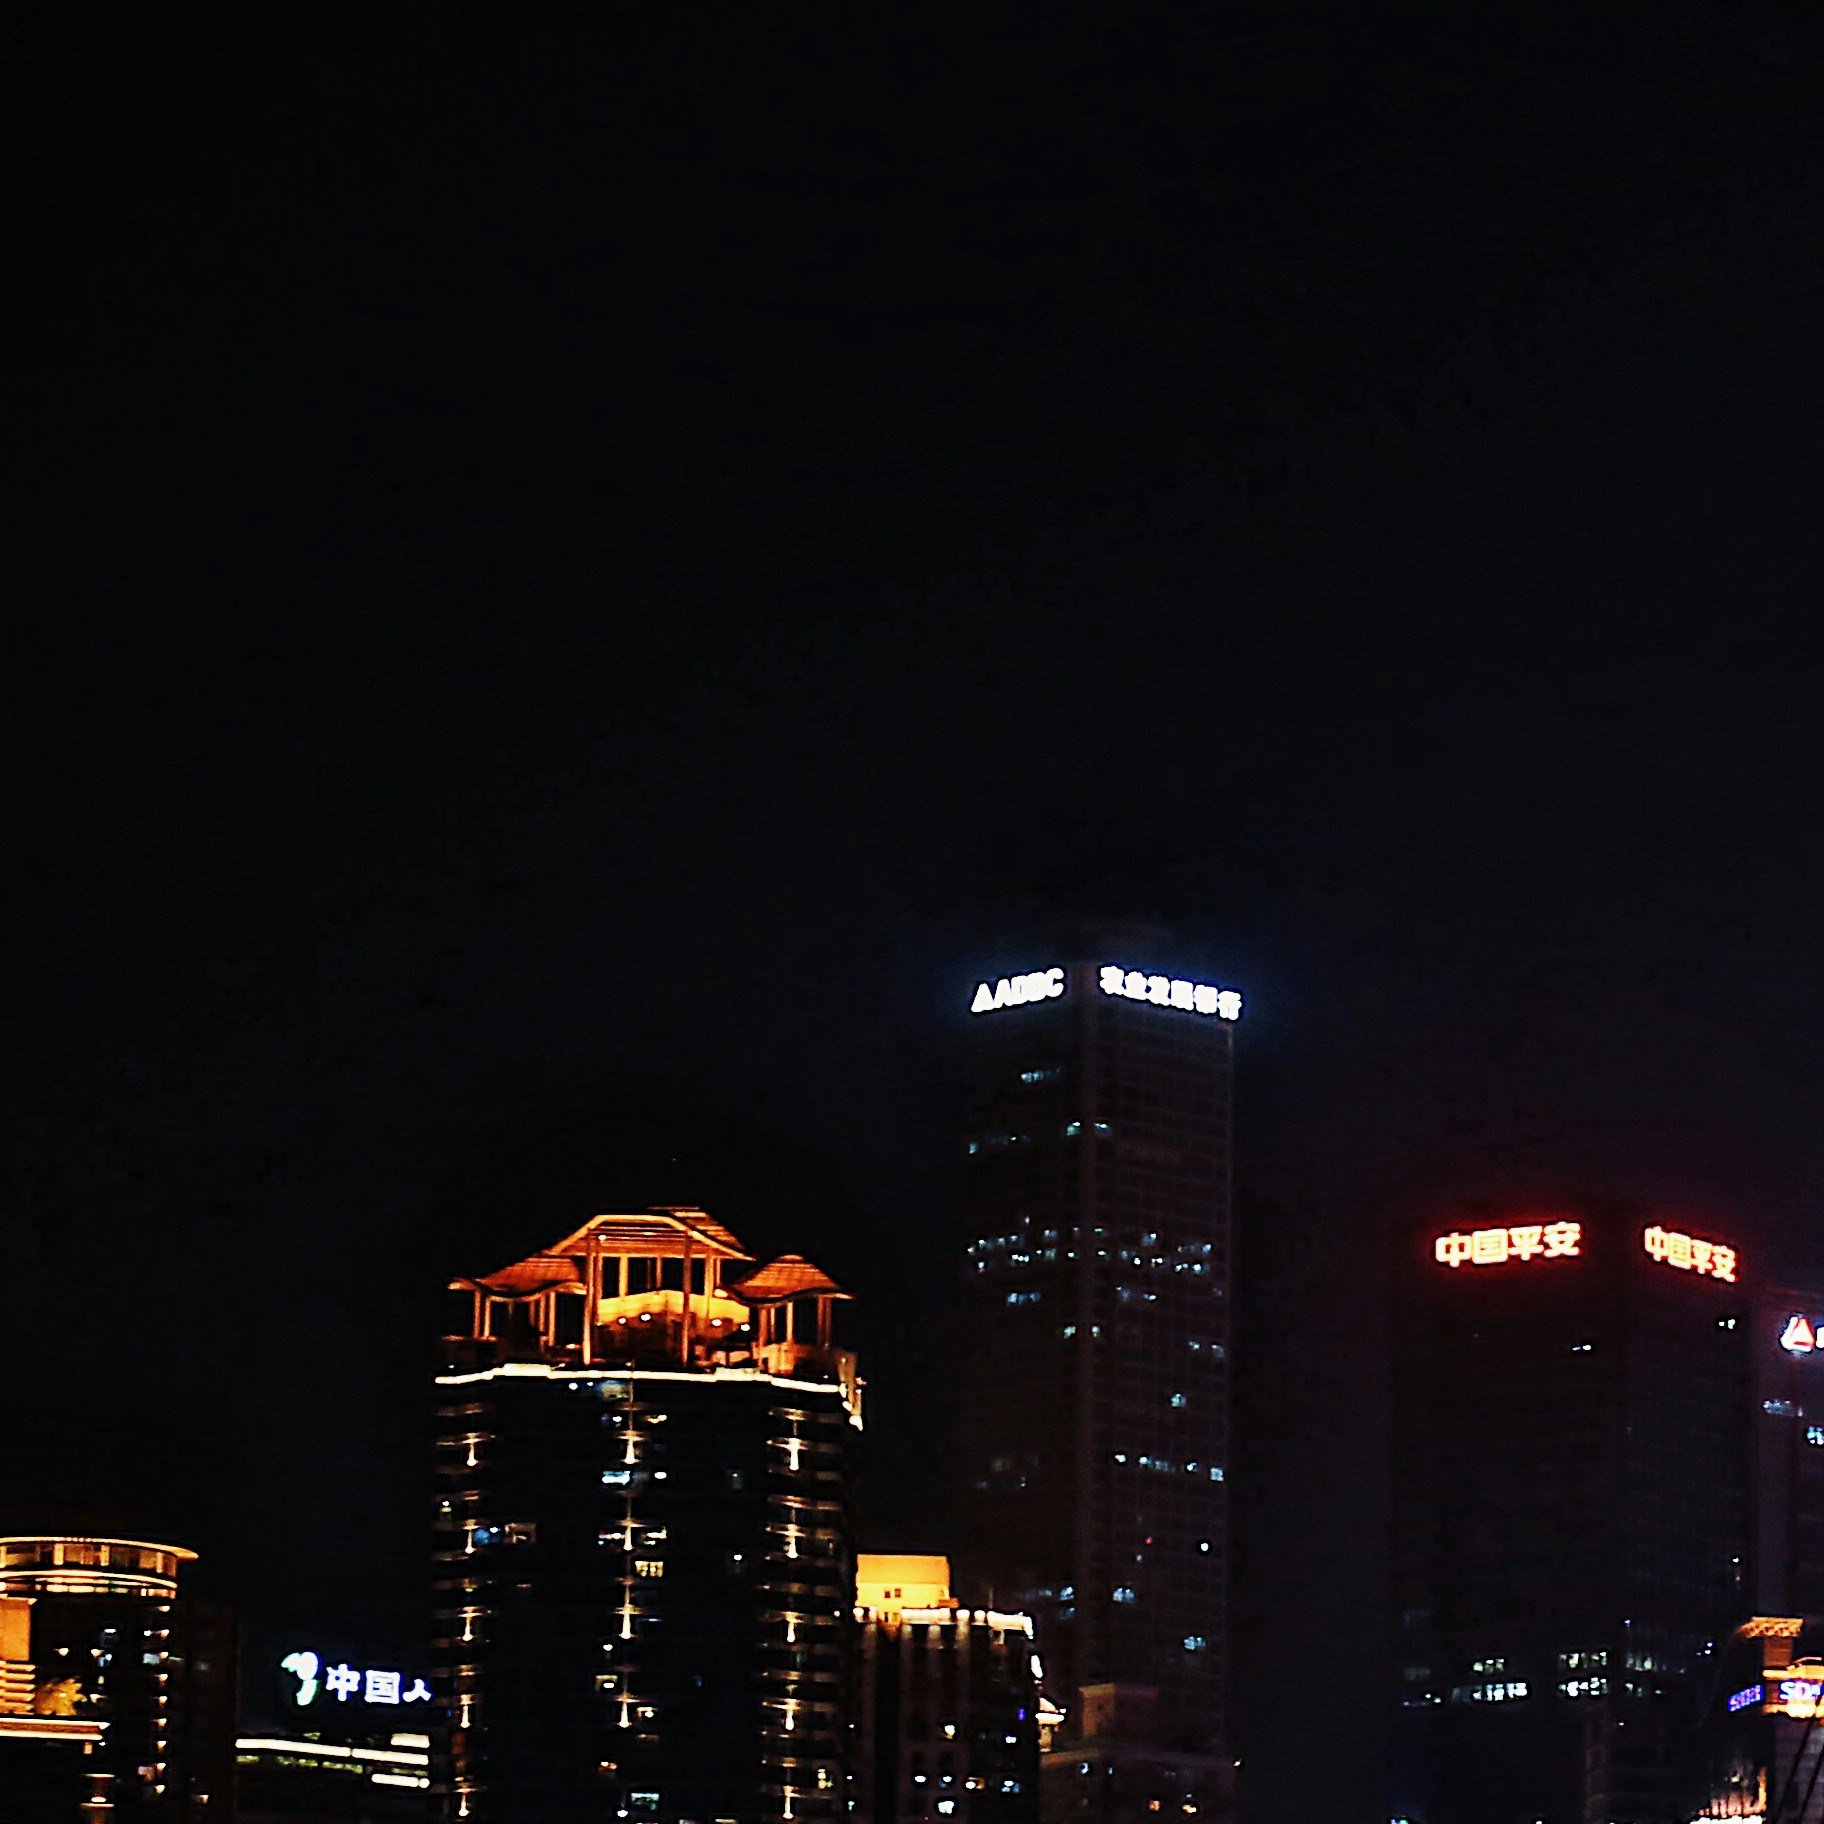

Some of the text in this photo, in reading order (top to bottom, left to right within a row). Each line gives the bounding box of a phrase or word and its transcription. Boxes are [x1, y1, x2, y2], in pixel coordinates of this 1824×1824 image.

[1436, 1222, 1582, 1267] 中国平安
[1645, 1226, 1738, 1282] 中国平安
